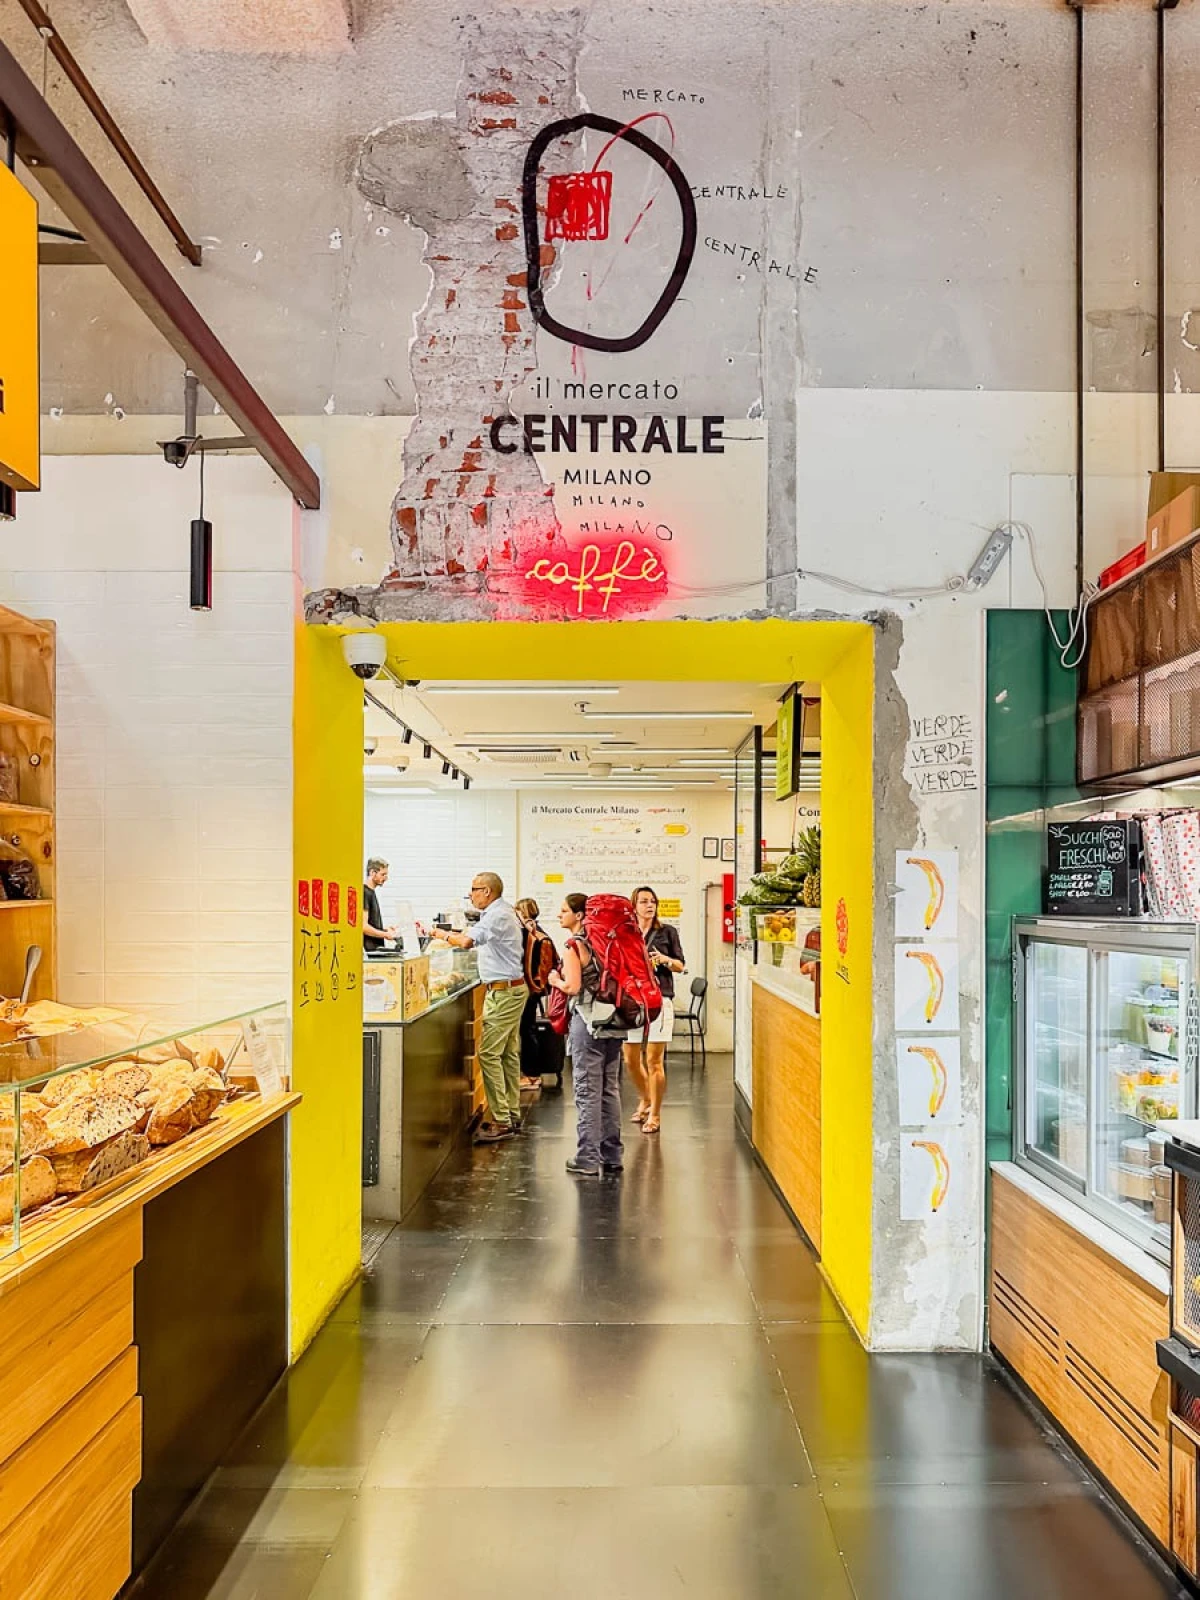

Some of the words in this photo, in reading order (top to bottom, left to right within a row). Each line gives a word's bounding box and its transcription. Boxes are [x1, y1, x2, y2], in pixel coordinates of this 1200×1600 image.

[622, 88, 705, 104] MERCATO
[704, 236, 819, 283] CENTRALE
[536, 376, 550, 399] il
[564, 379, 678, 400] mercato
[489, 414, 725, 454] CENTRALE
[563, 469, 652, 485] MILANO
[572, 495, 645, 508] MILANO
[580, 519, 673, 541] MILANO
[525, 540, 665, 613] caffè
[912, 714, 973, 737] VERDE
[911, 739, 974, 763] VERDE
[913, 770, 977, 790] VERDE
[539, 805, 573, 814] Mercato
[574, 805, 608, 814] Centrale
[610, 805, 640, 814] Milano
[1059, 826, 1103, 846] SUCCHI
[1059, 848, 1106, 866] FRESCHI
